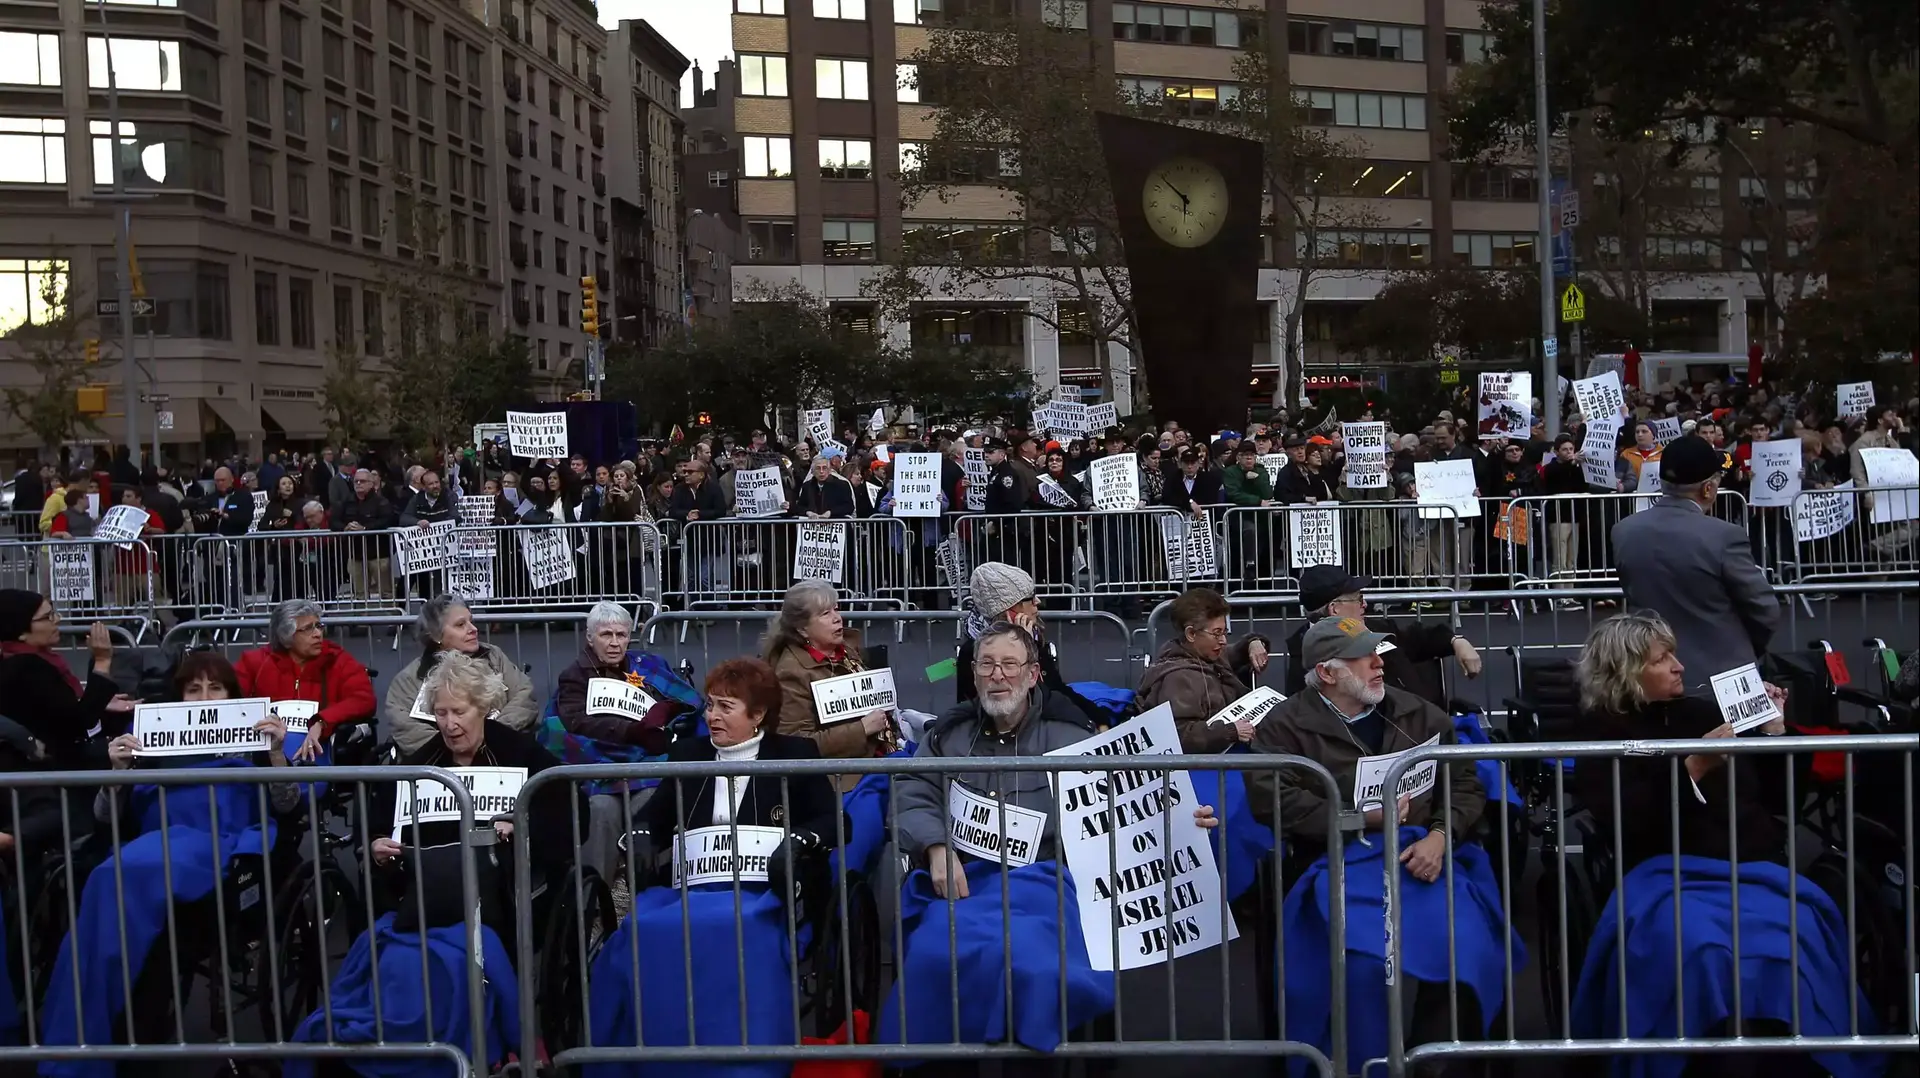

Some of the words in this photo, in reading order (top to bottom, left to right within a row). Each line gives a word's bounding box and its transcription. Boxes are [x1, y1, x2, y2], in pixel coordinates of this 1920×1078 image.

[1563, 212, 1577, 225] 25
[1564, 309, 1583, 319] AHEAD
[1483, 374, 1494, 383] We
[1483, 383, 1492, 392] All
[1493, 384, 1509, 392] Leon
[1602, 385, 1616, 416] HAMAS
[1611, 388, 1622, 407] PLO
[1050, 402, 1084, 413] KLINGHOFFER
[1587, 391, 1601, 420] ISIS
[510, 414, 563, 425] KLINGHOFFER
[1049, 411, 1085, 421] EXECUTED
[511, 424, 564, 436] EXECUTED
[1061, 420, 1079, 429] PLO
[1593, 422, 1612, 432] OPERA
[1344, 425, 1383, 437] KLINGHOFFER
[1586, 431, 1615, 442] JUSTIFIES
[519, 435, 528, 445] BY
[530, 436, 556, 446] PLO
[1348, 437, 1381, 448] OPERA
[1585, 440, 1612, 450] ATTACKS
[513, 445, 566, 457] TERRORISTS
[908, 456, 927, 465] STOP
[1093, 456, 1134, 469] KLINGHOFFER
[1347, 452, 1384, 463] PROPAGANDA
[1583, 457, 1611, 468] AMERICA
[1765, 458, 1791, 467] Terror
[1101, 463, 1126, 472] KAHANE
[1587, 467, 1608, 477] ISRAEL
[738, 472, 769, 481] CANCEL
[900, 471, 911, 480] THE
[918, 470, 937, 479] HATE
[1099, 471, 1115, 479] 1993
[1103, 476, 1127, 484] 9/11
[1354, 475, 1361, 486] AS
[1362, 474, 1381, 486] ART
[1592, 475, 1607, 485] JEWS
[753, 478, 778, 489] OPERA
[901, 484, 931, 493] DEFUND
[1099, 484, 1113, 492] FORT
[1104, 489, 1128, 498] BOSTON
[744, 498, 756, 506] THE
[900, 501, 913, 510] THE
[1097, 496, 1136, 505] WHAT'S
[803, 531, 838, 544] OPERA
[54, 552, 87, 564] OPERA
[803, 567, 811, 578] AS
[812, 569, 832, 580] ART
[852, 680, 857, 692] I
[861, 677, 873, 691] AM
[1733, 678, 1742, 697] I
[1741, 675, 1751, 693] AM
[625, 688, 629, 698] I
[632, 691, 646, 704] AM
[592, 696, 615, 708] LEON
[617, 700, 648, 717] KLINGH
[824, 700, 848, 715] LEON
[850, 689, 894, 710] KLINGHOFFER
[1231, 704, 1246, 718] AM
[1725, 704, 1740, 724] LEON
[1739, 692, 1773, 720] KLINGHOFFER
[187, 710, 192, 726] I
[198, 708, 218, 725] AM
[143, 731, 175, 748] LEON
[179, 726, 261, 747] KLINGHOFFER
[962, 801, 969, 817] I
[970, 804, 991, 825] AM
[1080, 780, 1182, 841] ATTACKS
[703, 836, 708, 852] I
[713, 834, 732, 851] AM
[1132, 829, 1160, 853] ON
[1092, 845, 1203, 902] AMERICA
[1111, 880, 1204, 928] ISRAEL
[1139, 915, 1202, 955] JEWS
